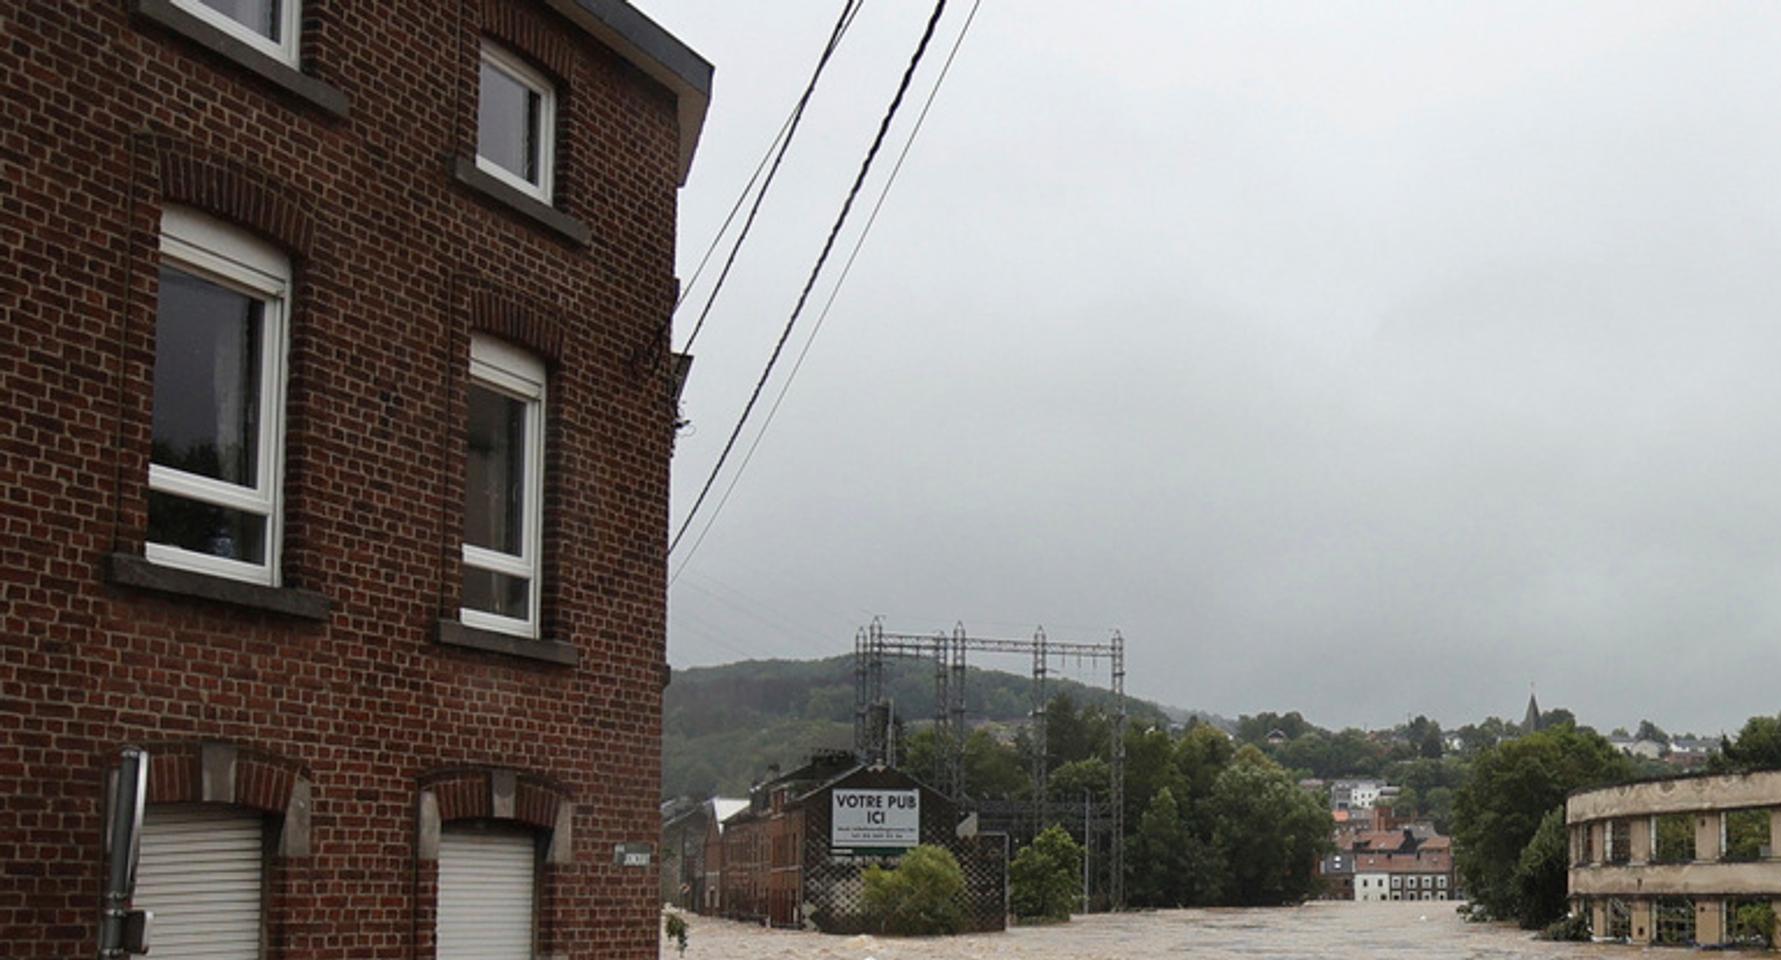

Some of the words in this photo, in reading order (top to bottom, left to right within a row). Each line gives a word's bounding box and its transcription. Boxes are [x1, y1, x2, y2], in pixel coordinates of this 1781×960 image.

[836, 794, 883, 809] VOTRE
[888, 794, 917, 809] PUB
[867, 811, 885, 824] ICI
